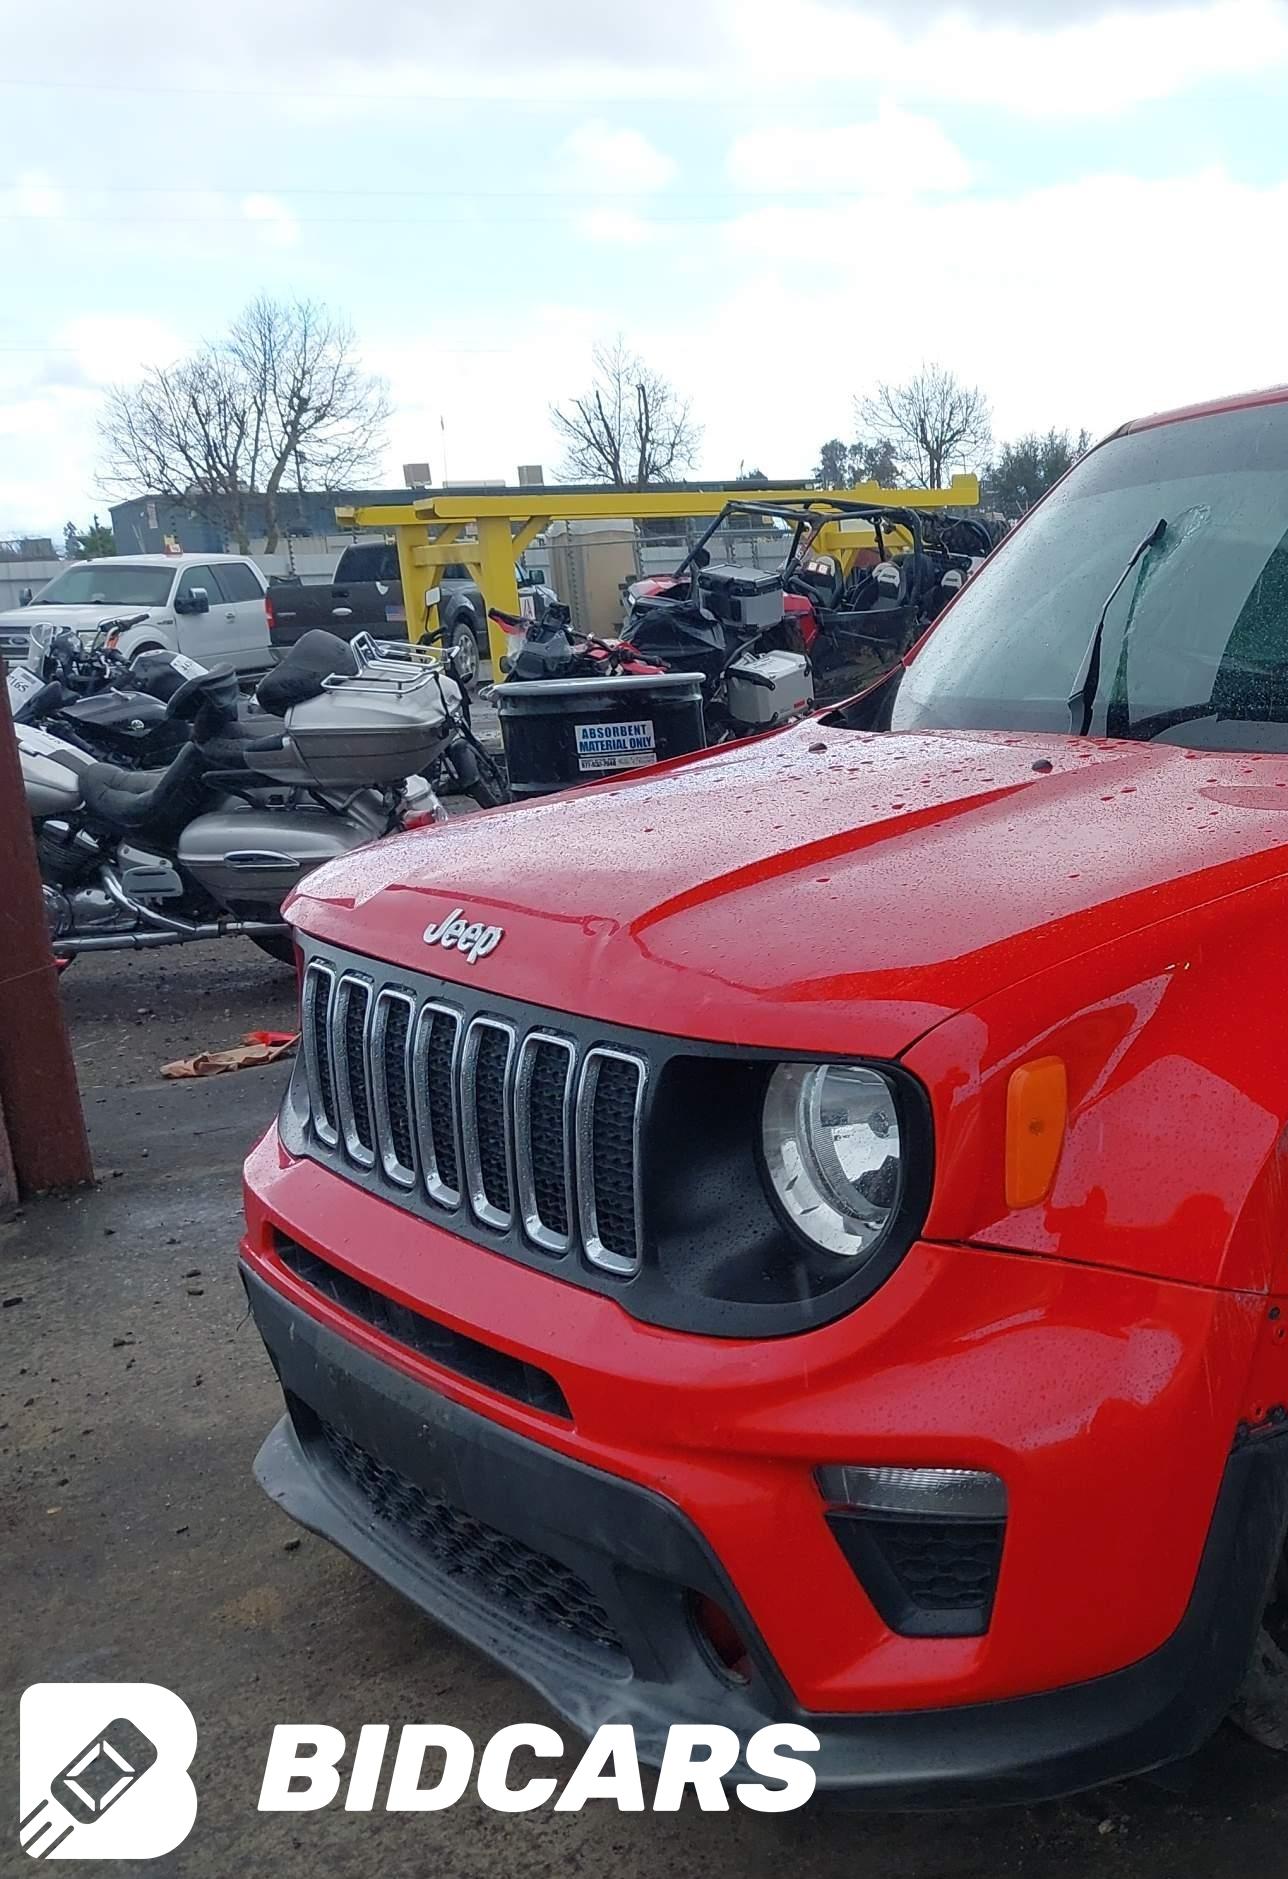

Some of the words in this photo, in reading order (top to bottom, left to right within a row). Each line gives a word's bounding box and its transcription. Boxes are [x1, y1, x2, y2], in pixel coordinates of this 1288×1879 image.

[582, 724, 647, 740] ABSORBENT
[579, 739, 629, 753] MATERIAL
[629, 736, 652, 749] ONLY
[422, 907, 505, 966] Jeep
